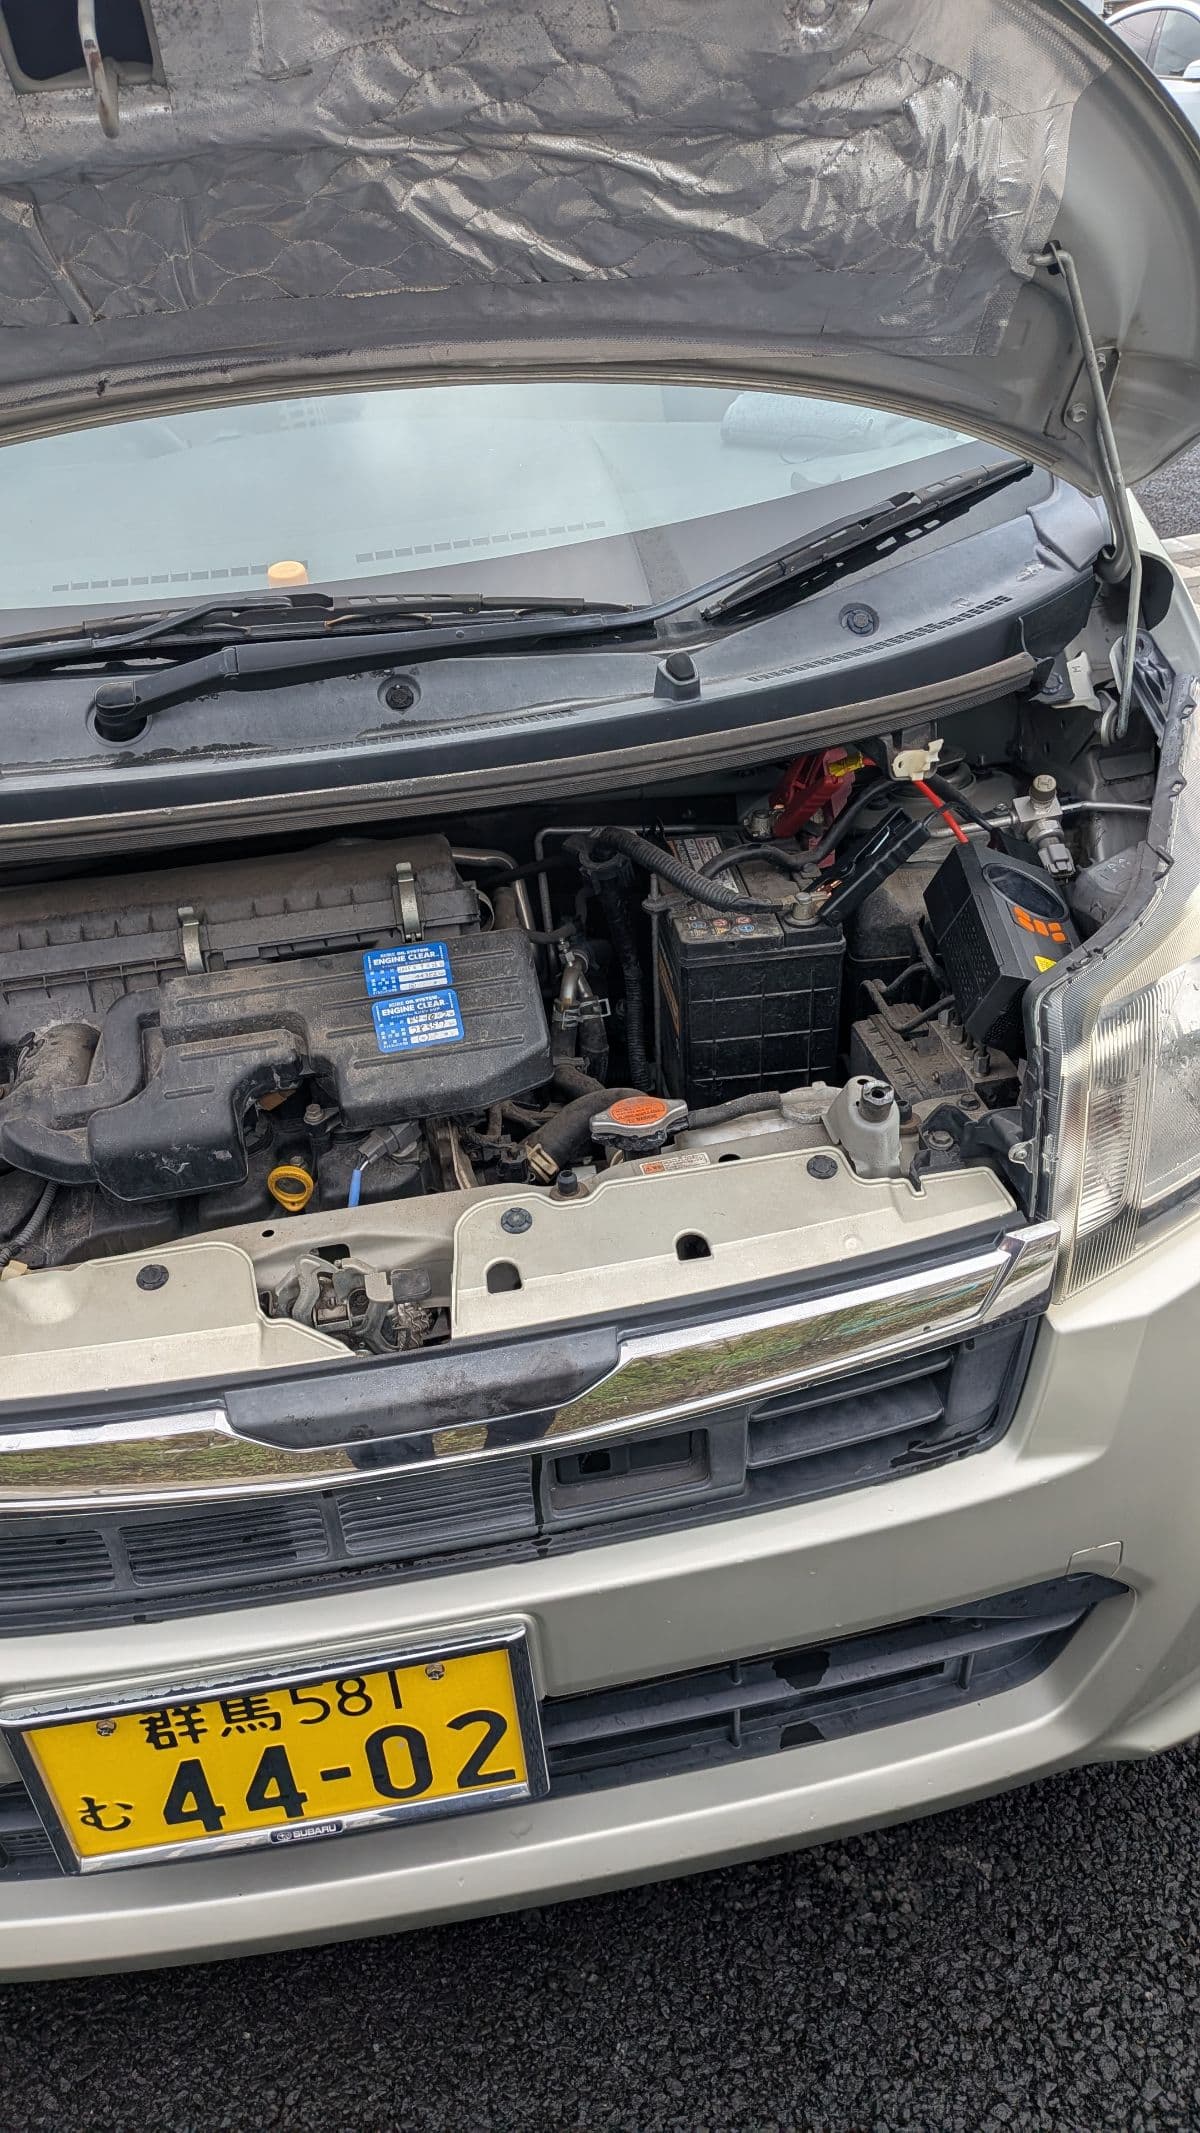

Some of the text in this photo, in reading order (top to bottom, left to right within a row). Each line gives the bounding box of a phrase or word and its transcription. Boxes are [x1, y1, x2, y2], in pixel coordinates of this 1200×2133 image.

[373, 955, 406, 966] ENGINE
[407, 950, 436, 961] CLEAR
[381, 1004, 415, 1016] ENGINE
[416, 999, 445, 1011] CLEAR
[138, 1670, 403, 1751] 群馬 581
[78, 1709, 517, 1833] む 44-02
[292, 1823, 337, 1839] SUBARU
